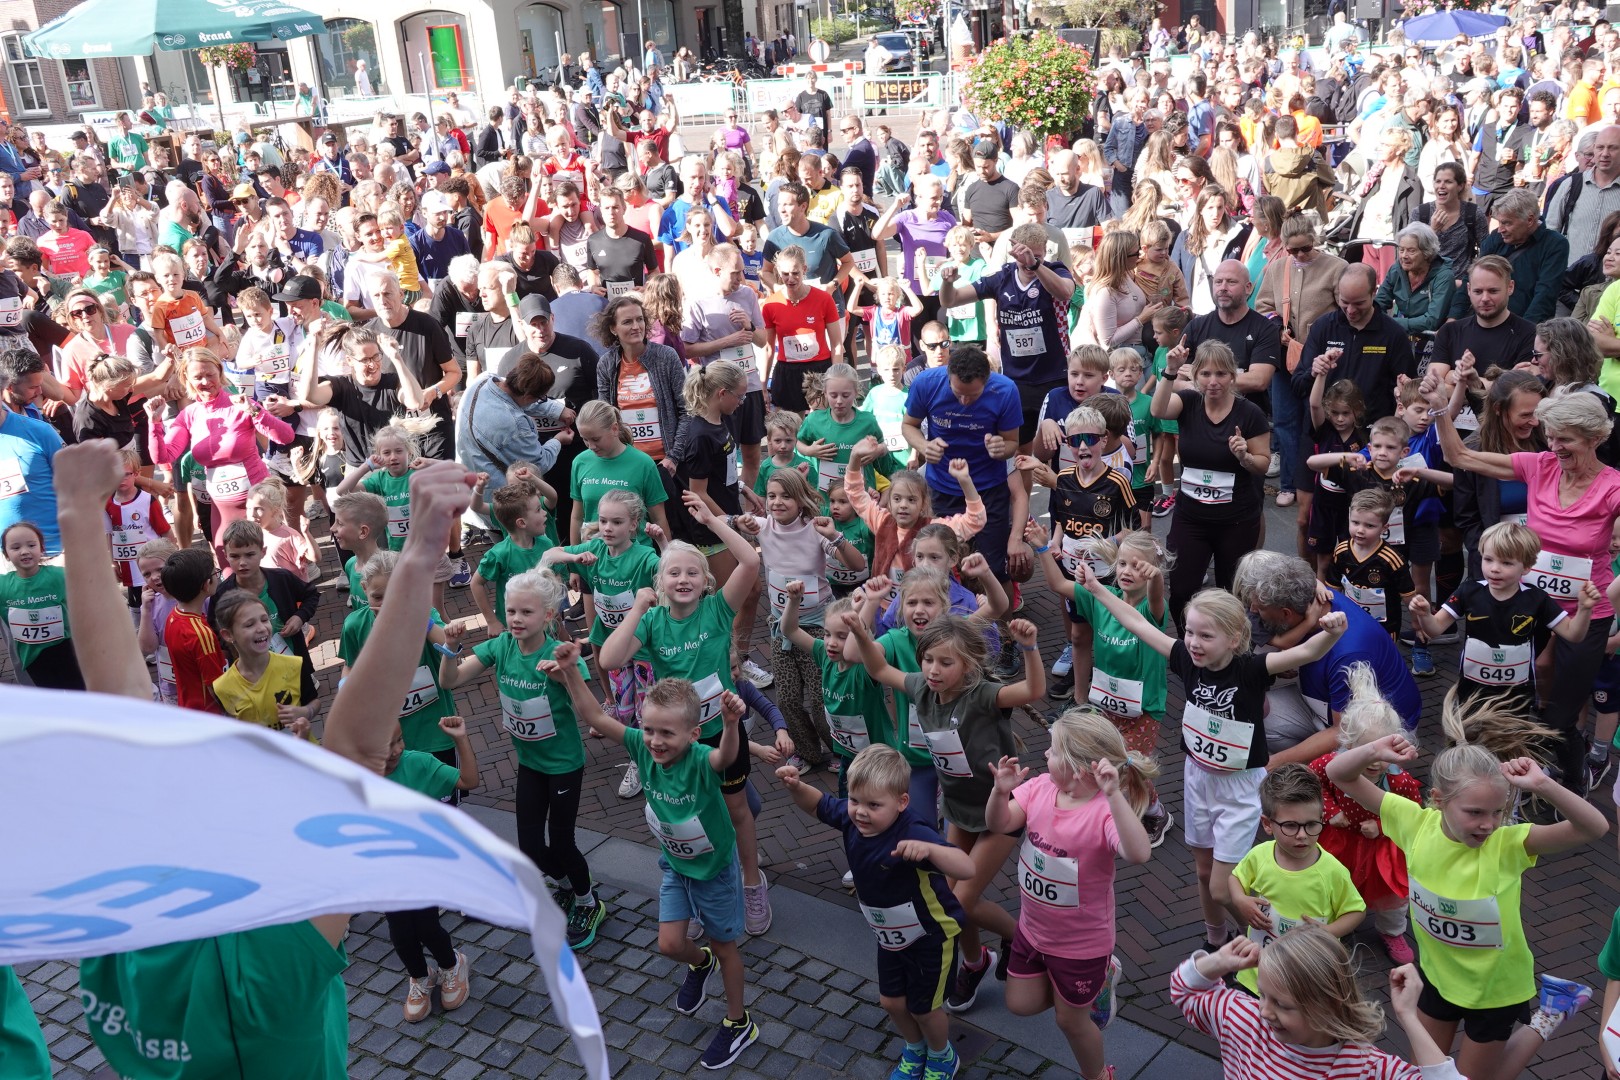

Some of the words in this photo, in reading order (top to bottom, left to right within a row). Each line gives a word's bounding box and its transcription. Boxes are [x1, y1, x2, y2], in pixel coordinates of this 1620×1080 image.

[199, 31, 233, 43] Brand
[185, 327, 204, 341] 445
[1015, 338, 1034, 348] 587
[738, 360, 750, 369] 94
[535, 418, 557, 429] 382
[216, 481, 240, 494] 638
[601, 479, 629, 487] Maerte
[1193, 487, 1220, 500] 490
[1065, 517, 1103, 536] ziggo
[117, 546, 138, 558] 565
[833, 570, 857, 581] 425
[1537, 575, 1571, 594] 648
[27, 594, 58, 605] Maerte
[22, 626, 50, 640] 475
[660, 645, 681, 657] Sinte
[1480, 667, 1516, 681] 649
[1100, 695, 1128, 714] 493
[509, 719, 538, 736] 502
[1193, 735, 1228, 762] 345
[1024, 872, 1058, 900] 606
[1428, 916, 1476, 941] 603
